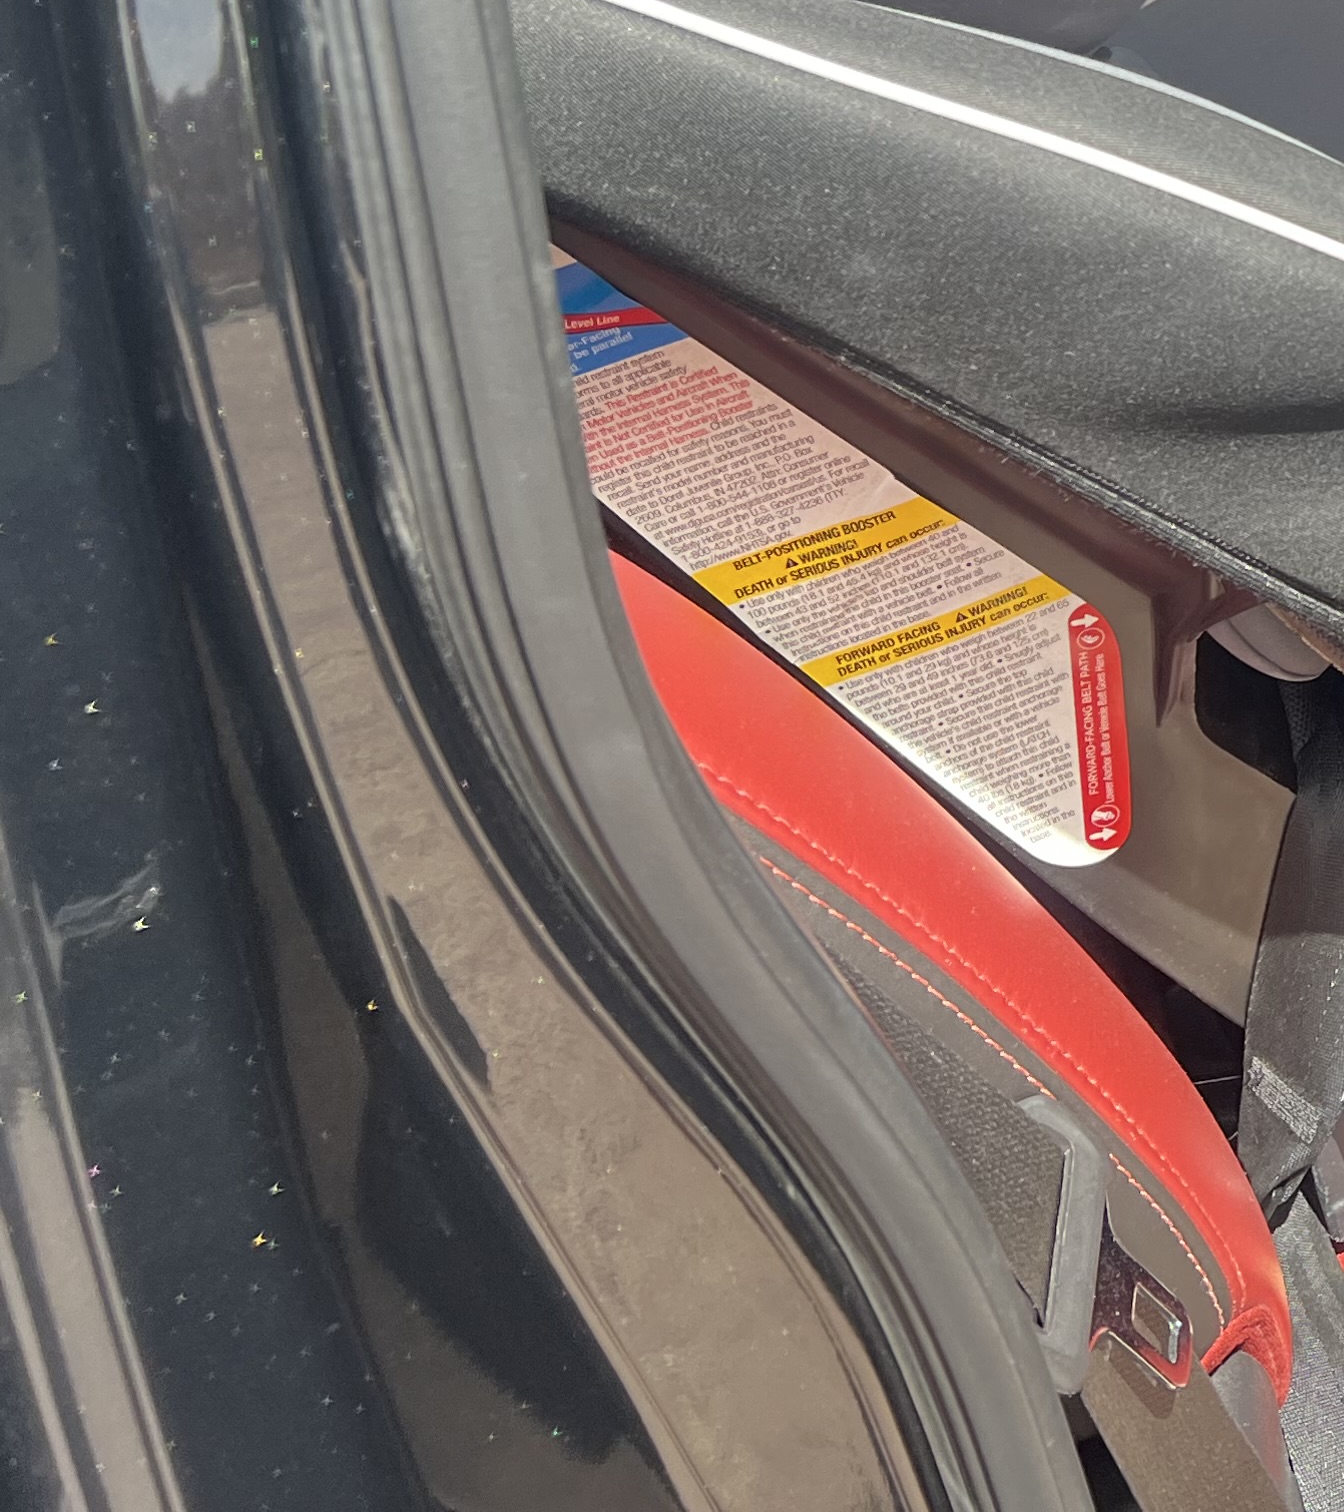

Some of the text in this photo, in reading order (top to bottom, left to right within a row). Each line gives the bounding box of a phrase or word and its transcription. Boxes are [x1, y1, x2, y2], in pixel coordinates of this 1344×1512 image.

[564, 317, 621, 328] Level Line
[592, 332, 633, 355] parallel
[606, 400, 626, 411] This
[627, 383, 669, 403] Restraint
[734, 511, 896, 570] BELT-POSITIONING BOOSTER
[735, 579, 774, 599] DEATH
[777, 577, 789, 585] or
[790, 559, 840, 581] SERIOUS
[841, 543, 883, 565] INJURY
[886, 536, 907, 549] can
[798, 539, 858, 565] WARNING!
[836, 587, 1027, 665] FORWARD FACING WARNING!
[838, 657, 877, 677] DEATH
[879, 653, 892, 662] or
[893, 633, 944, 657] SERIOUS
[945, 616, 987, 639] INJURY
[990, 608, 1011, 622] can
[1080, 652, 1099, 795] FORWARD-FACING BELT PATH
